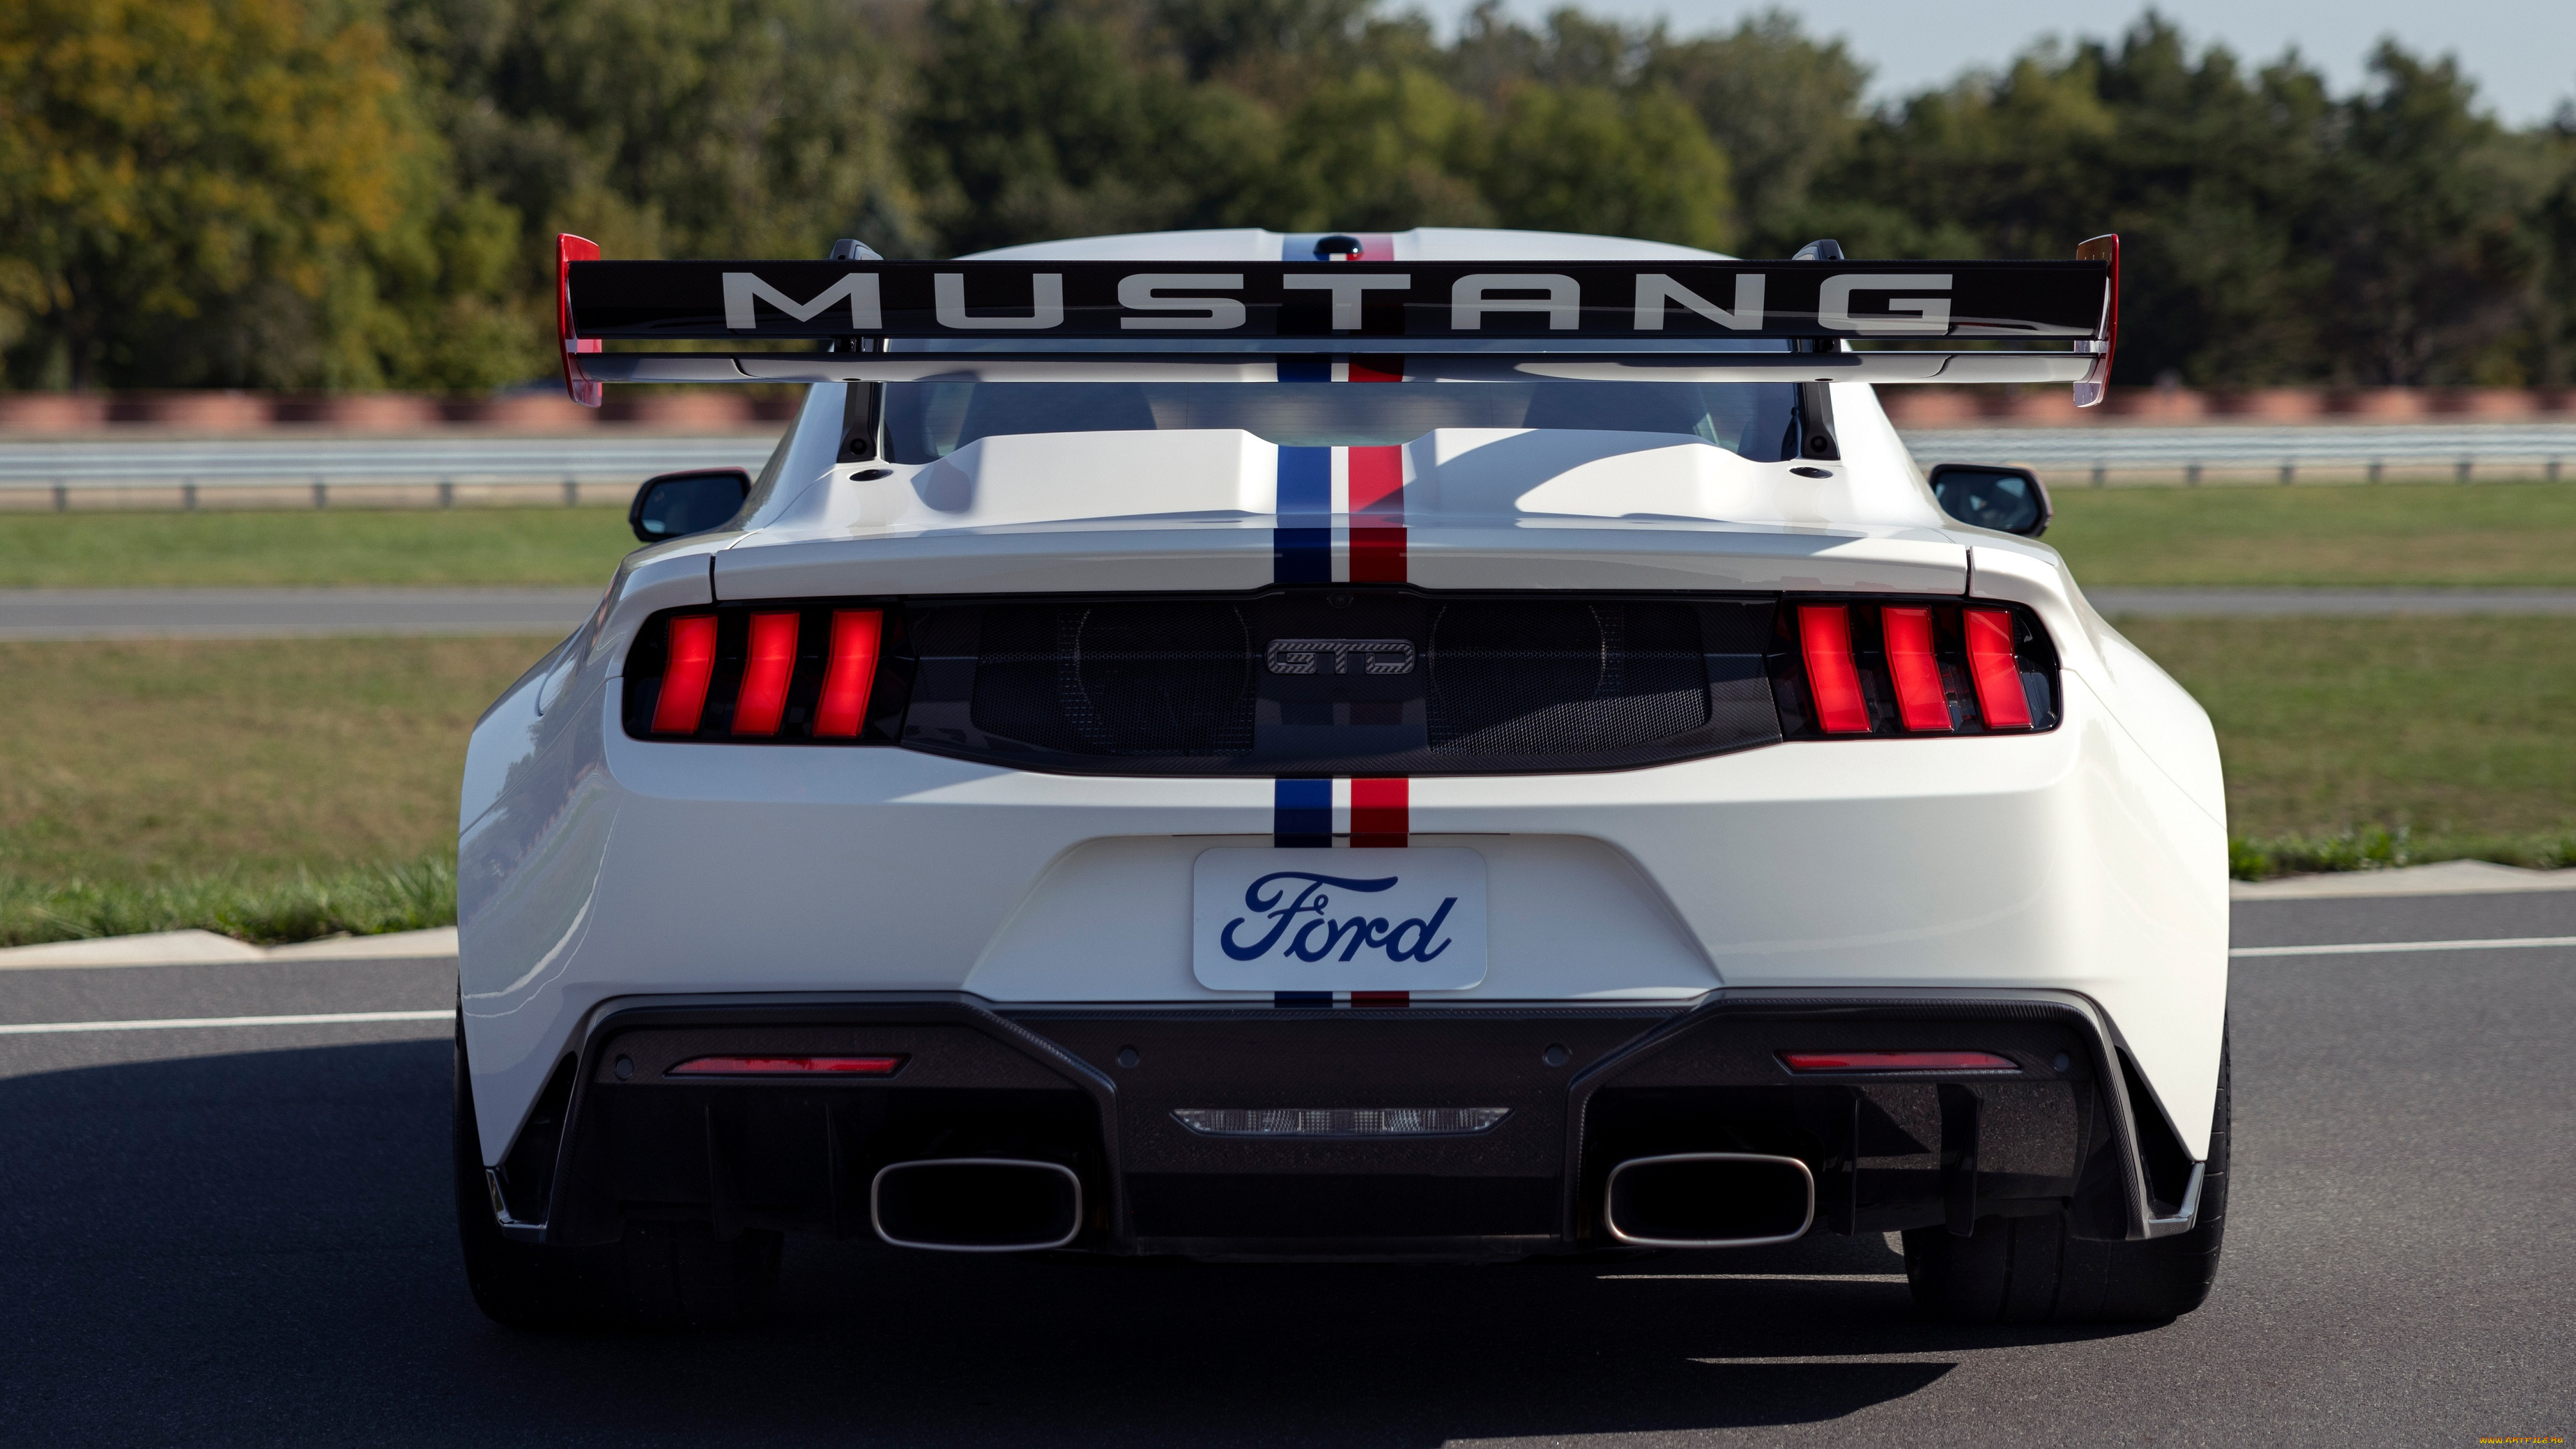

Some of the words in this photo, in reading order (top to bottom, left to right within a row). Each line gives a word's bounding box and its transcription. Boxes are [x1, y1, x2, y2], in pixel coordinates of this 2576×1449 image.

[723, 272, 1953, 330] MUSTANG
[1267, 639, 1415, 674] GTD
[1220, 871, 1458, 962] Ford
